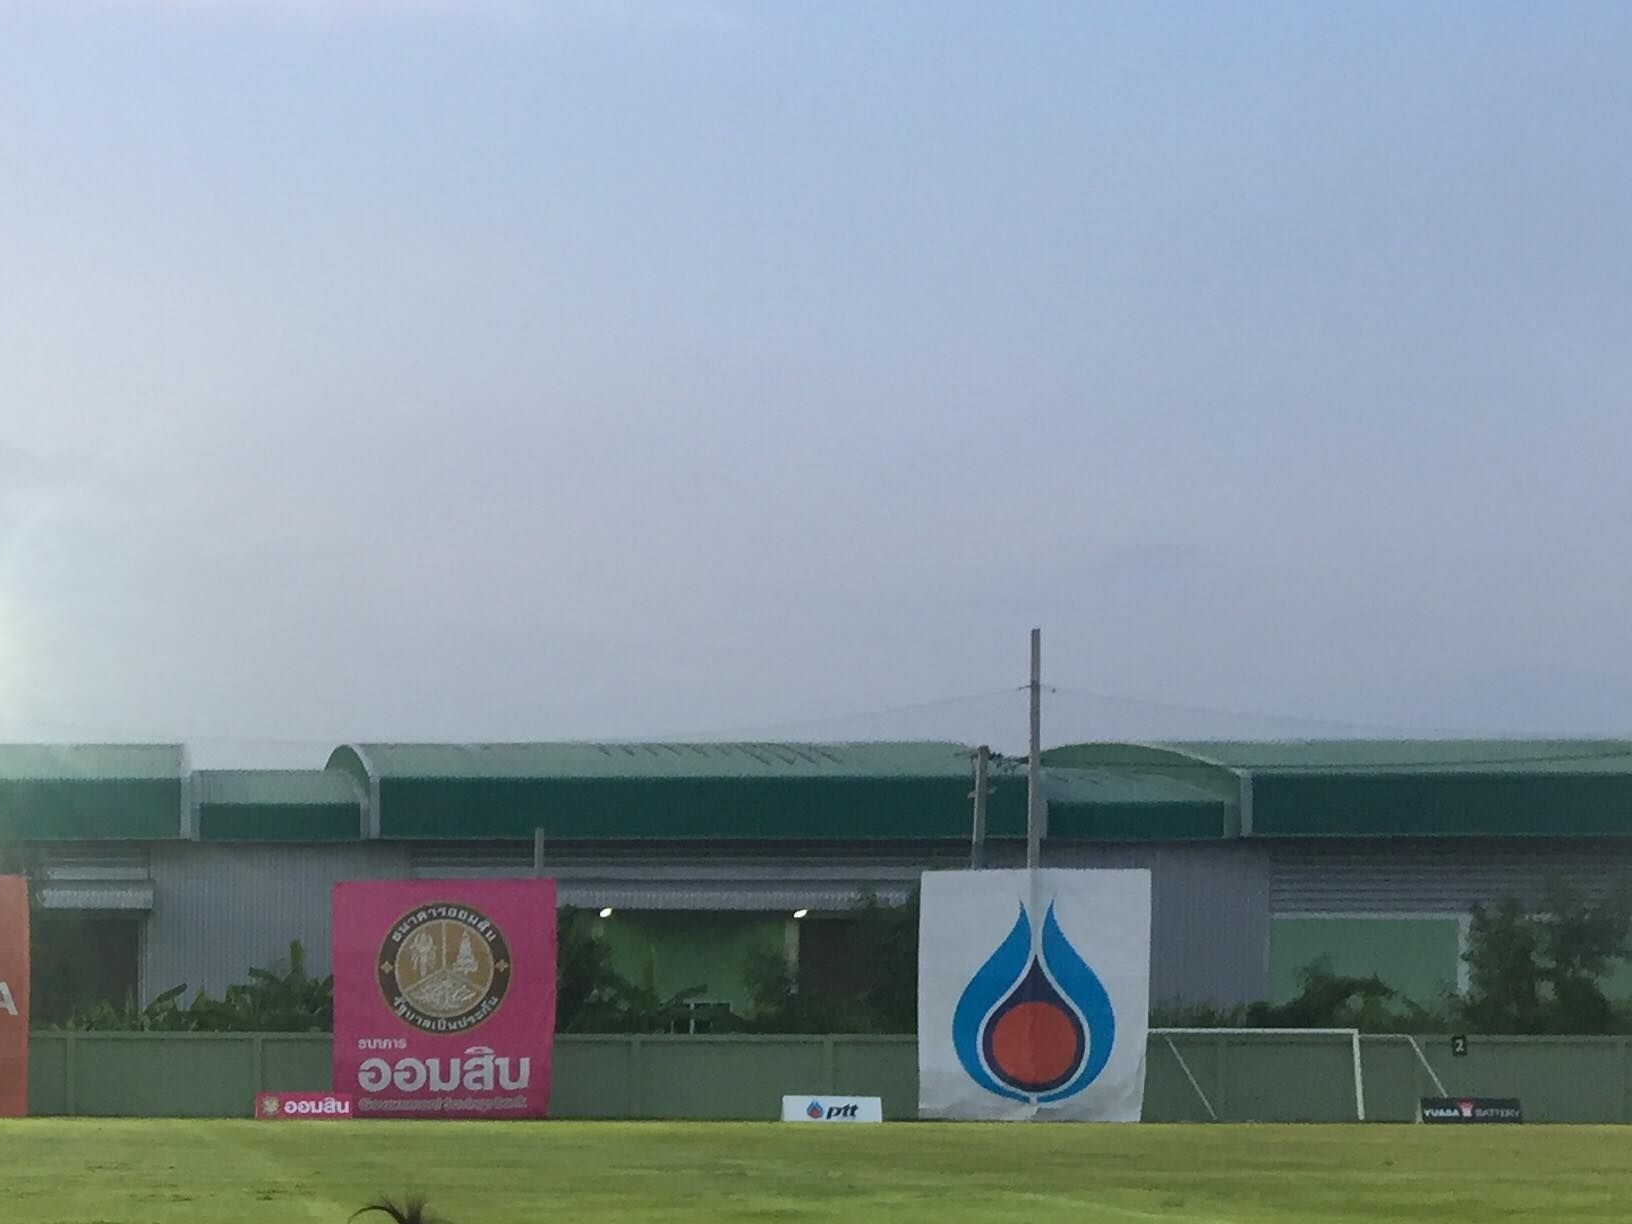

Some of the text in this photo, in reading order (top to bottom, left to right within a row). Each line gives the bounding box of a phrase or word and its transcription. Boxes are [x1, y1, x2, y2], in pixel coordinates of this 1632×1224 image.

[391, 906, 497, 943] ธนาคารออมสิน
[358, 1038, 407, 1050] ธนาคาร
[1455, 1040, 1464, 1052] 2
[358, 1046, 531, 1092] ออมสิน
[285, 1098, 350, 1114] ออมสิน
[826, 1104, 859, 1120] ptt
[1424, 1108, 1460, 1117] YUASA
